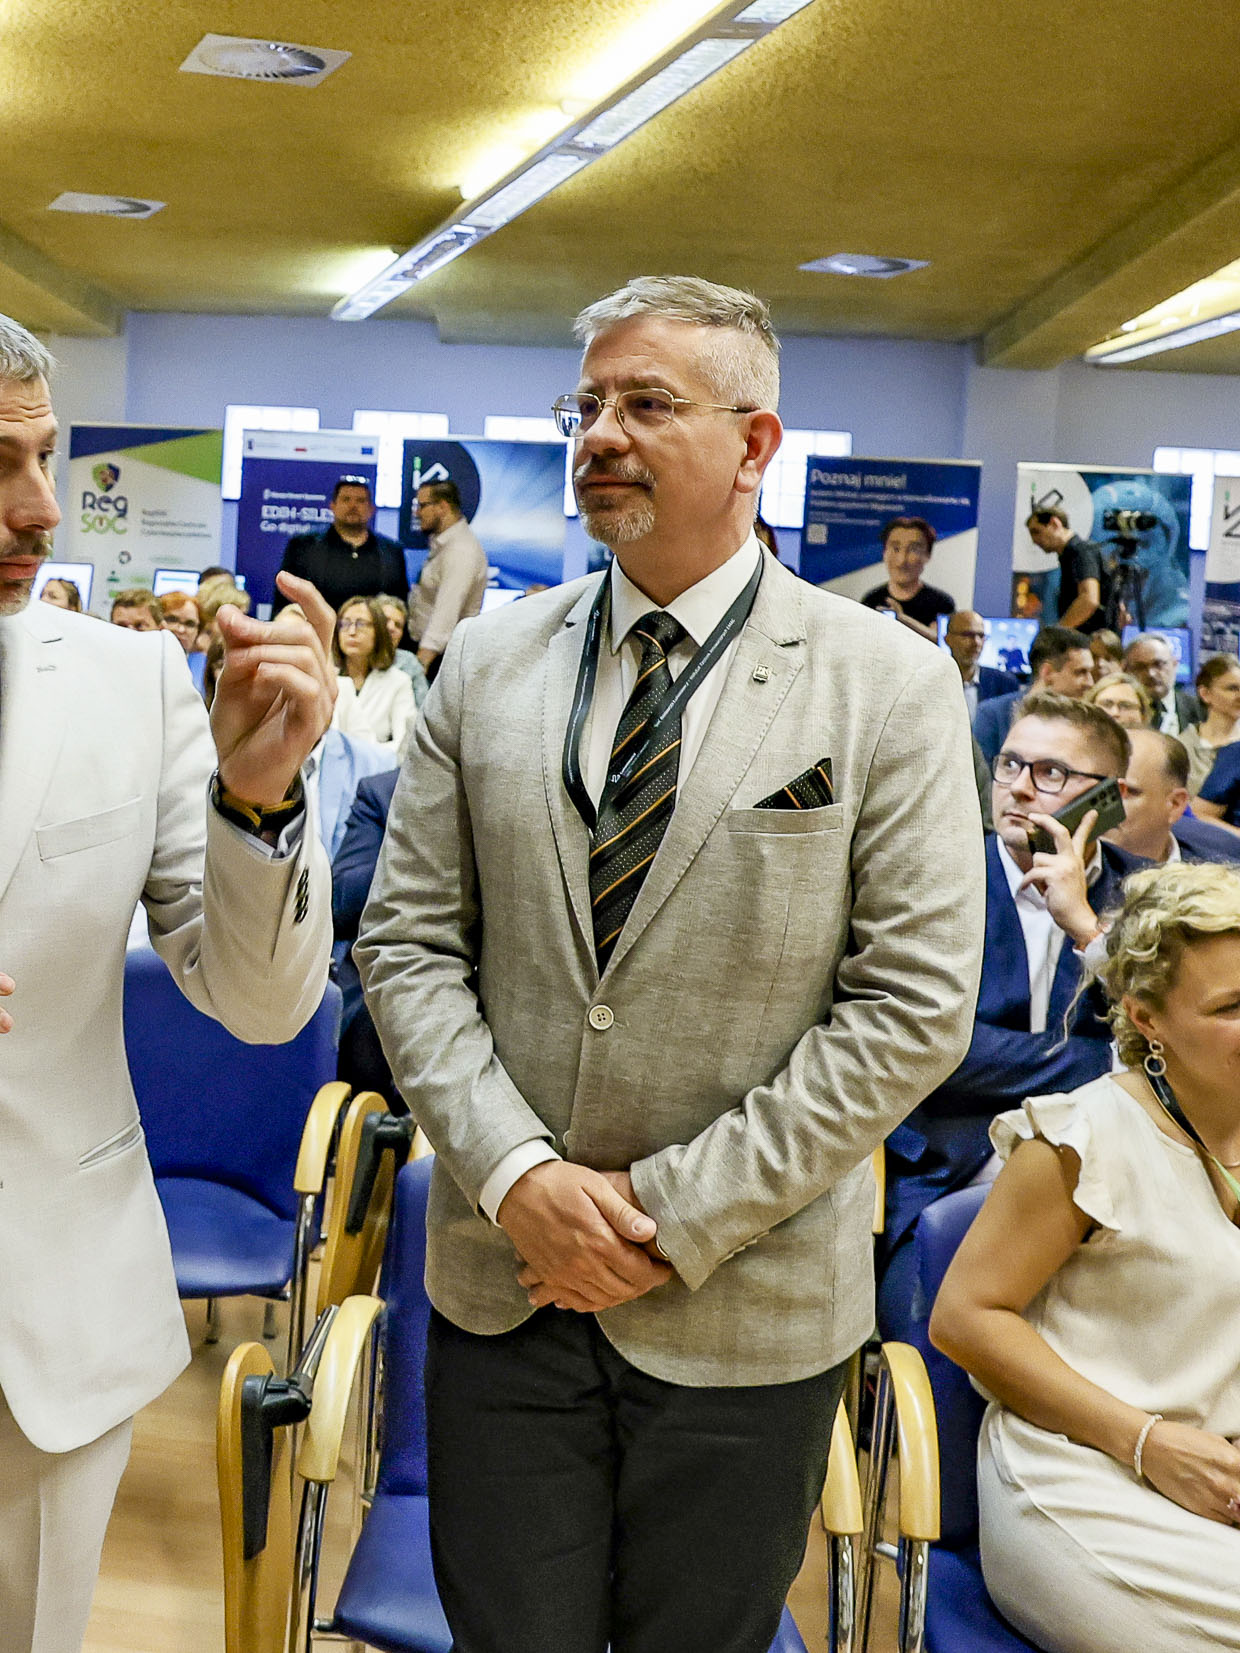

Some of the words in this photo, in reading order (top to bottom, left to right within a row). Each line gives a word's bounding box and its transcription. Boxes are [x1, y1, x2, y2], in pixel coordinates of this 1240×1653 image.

[811, 468, 862, 488] Poznaj
[82, 491, 128, 518] Reg
[80, 512, 128, 535] SOC
